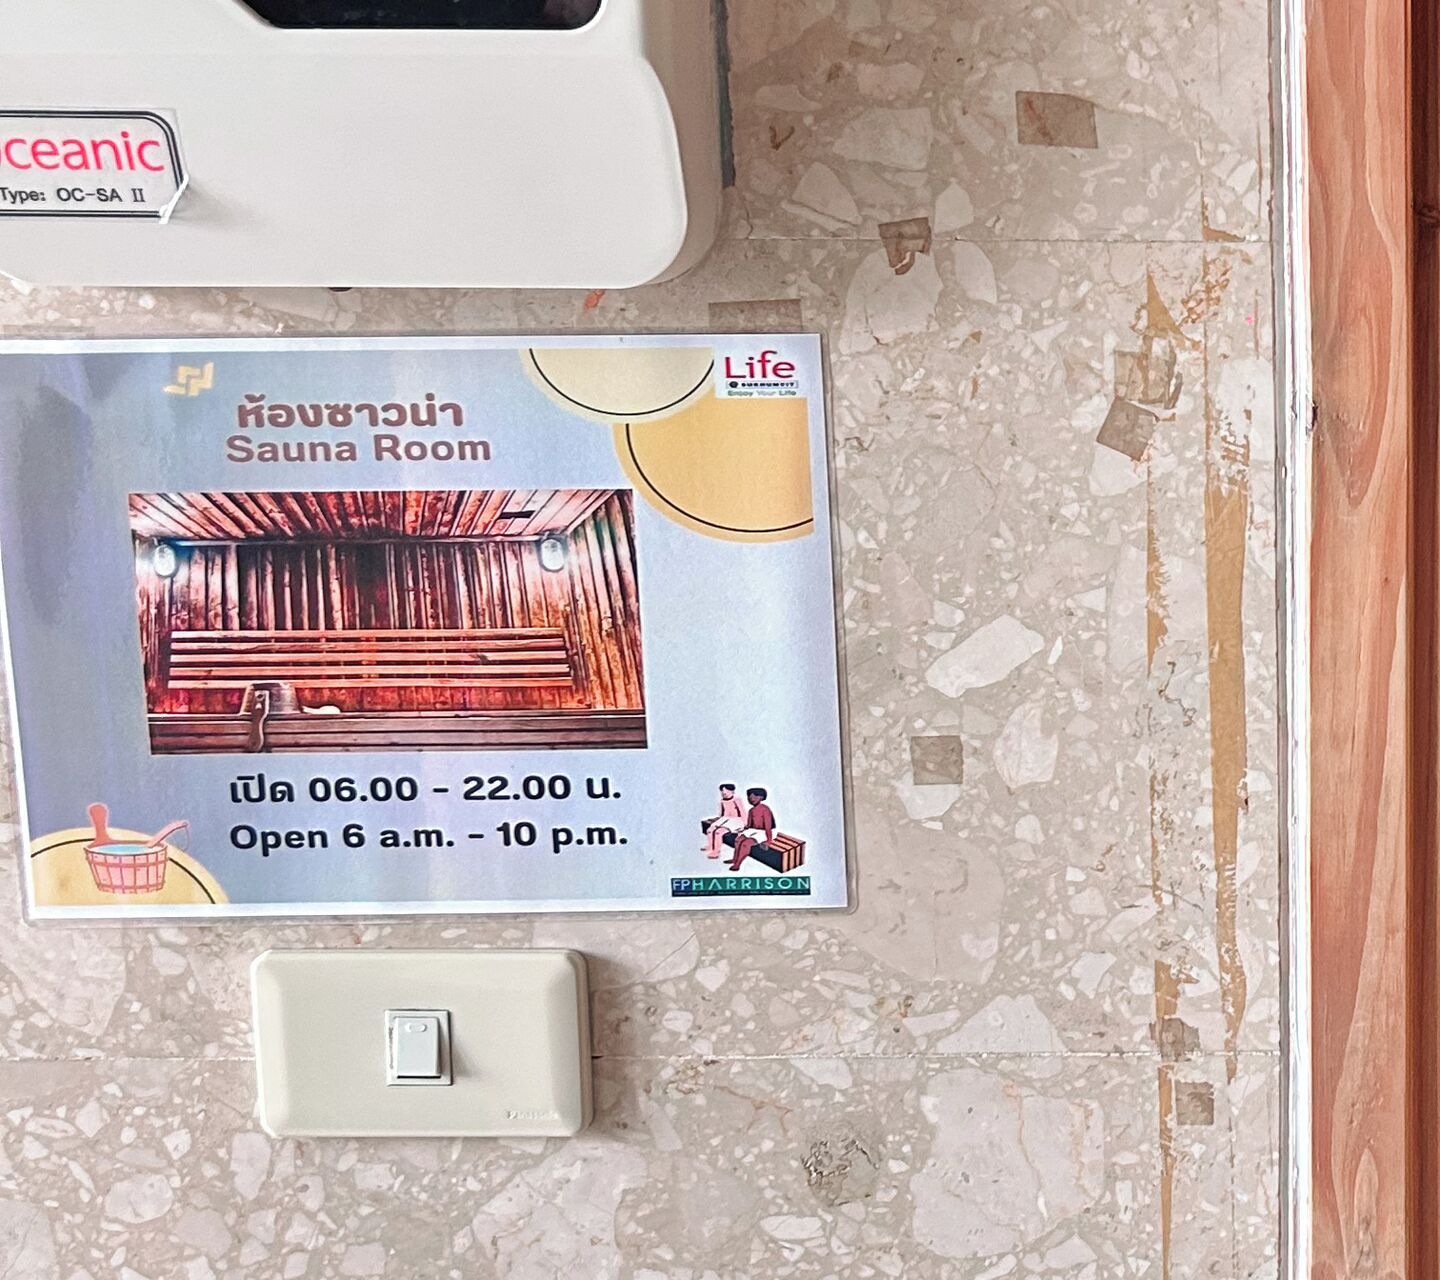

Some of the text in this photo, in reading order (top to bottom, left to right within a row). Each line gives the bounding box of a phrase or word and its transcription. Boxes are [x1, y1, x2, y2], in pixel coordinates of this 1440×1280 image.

[0, 130, 165, 172] ceanic
[0, 187, 46, 204] Type:
[56, 187, 123, 203] OC-SA
[725, 350, 795, 378] Life
[237, 392, 464, 428] ห้องซาวน่า
[226, 433, 491, 463] Sauna Room
[230, 773, 295, 803] เปิด
[309, 776, 419, 802] 06.00
[463, 775, 572, 801] 22.00
[585, 776, 622, 800] น.
[230, 824, 328, 857] Open
[342, 823, 366, 849] 6
[380, 828, 455, 849] a.m.
[496, 822, 537, 847] 10
[552, 825, 628, 854] p.m.
